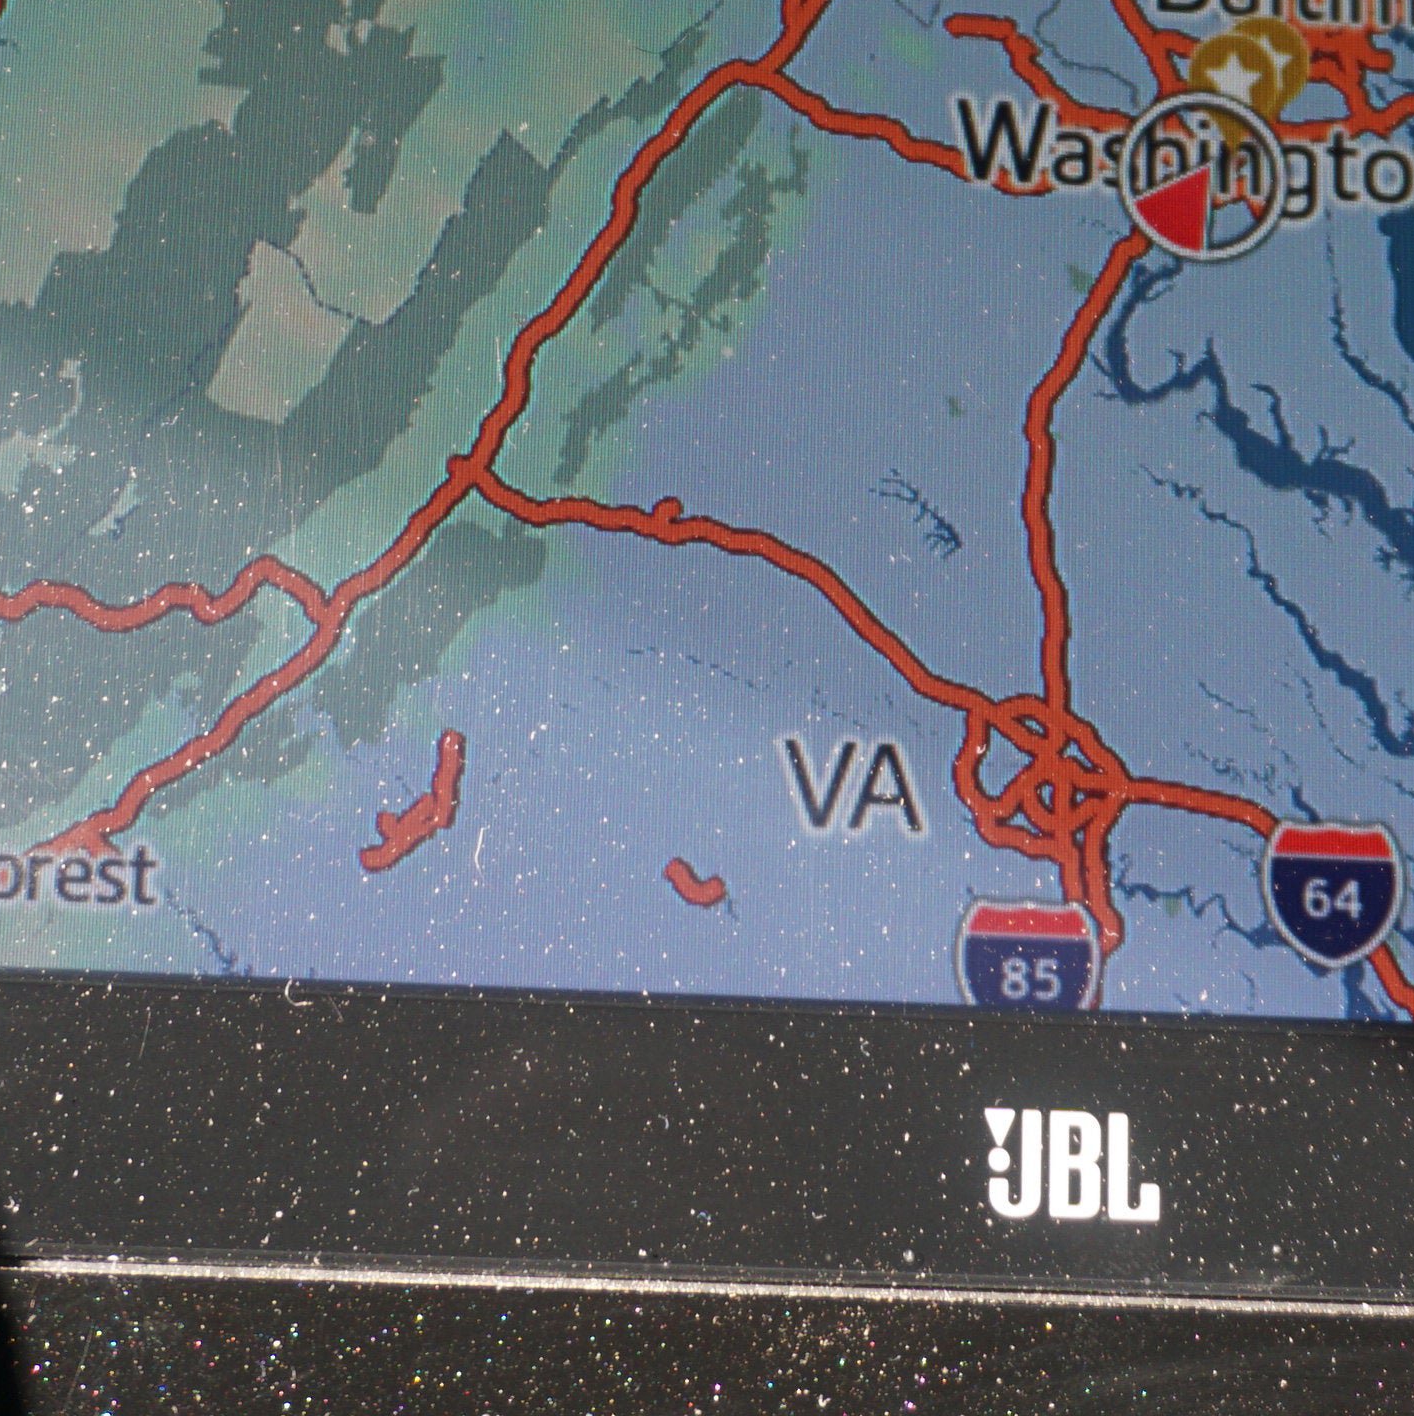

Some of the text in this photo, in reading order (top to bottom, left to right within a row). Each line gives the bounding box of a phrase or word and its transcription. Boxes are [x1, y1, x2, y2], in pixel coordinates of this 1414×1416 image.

[786, 739, 921, 830] VA
[1303, 878, 1362, 918] 64
[1000, 957, 1061, 1001] 85
[985, 1107, 1160, 1222] JBL
